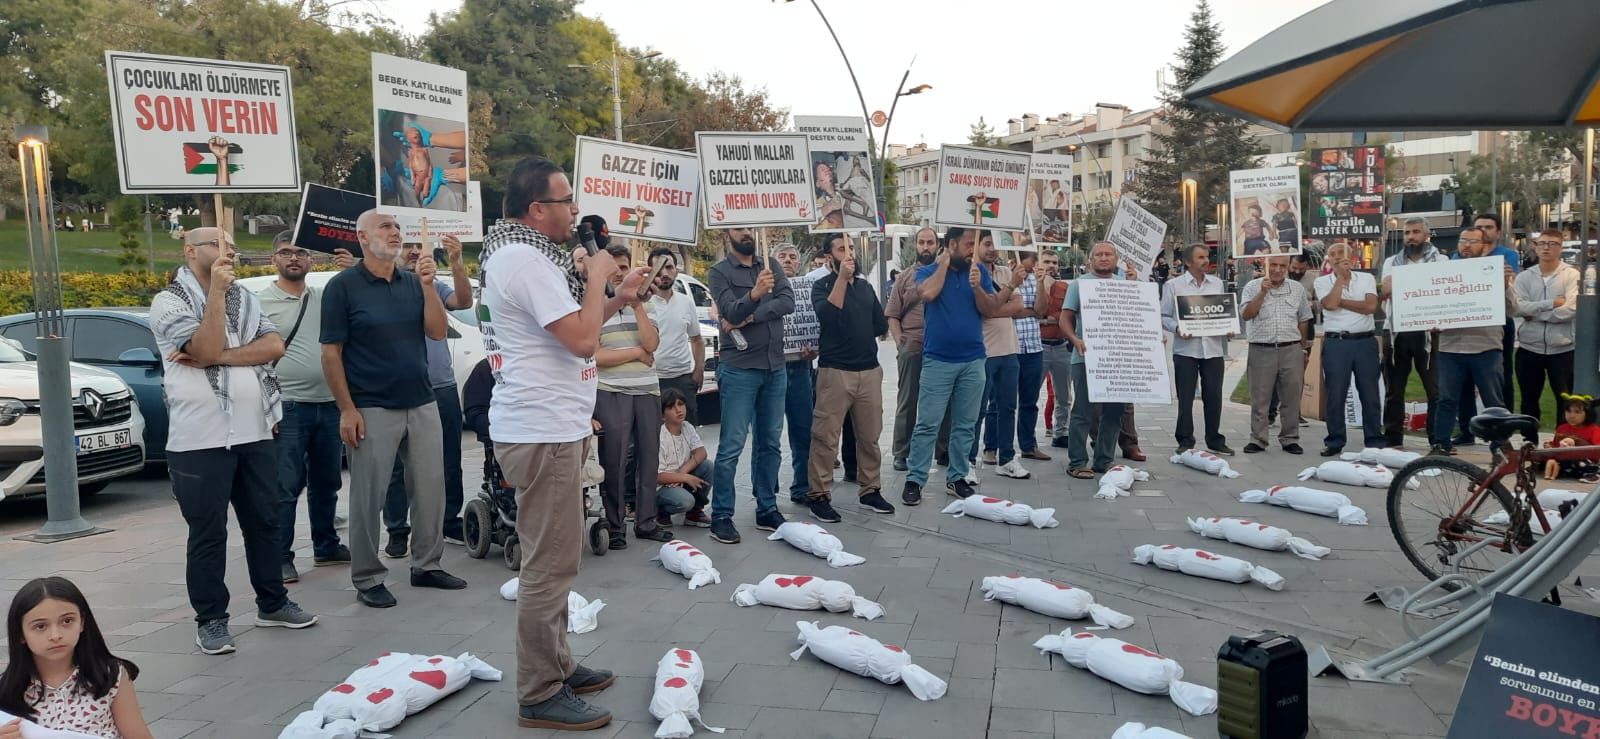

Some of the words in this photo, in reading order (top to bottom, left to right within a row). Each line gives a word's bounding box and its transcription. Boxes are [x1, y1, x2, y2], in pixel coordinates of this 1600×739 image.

[124, 68, 203, 90] ÇOCUKLARI
[207, 71, 281, 96] ÖLDÜRMEYE
[378, 74, 408, 86] BEBEK
[411, 80, 463, 96] KATİLLERİNE
[392, 88, 426, 100] DESTEK
[429, 95, 452, 105] OLMA
[134, 94, 195, 132] SON
[716, 141, 751, 160] YAHUDİ
[754, 144, 794, 160] MALLARI
[602, 154, 646, 176] GAZZE
[650, 157, 679, 181] İÇİN
[963, 156, 990, 171] DÜNYANIN
[709, 165, 749, 186] GAZZELİ
[751, 168, 806, 186] ÇOCUKLARA
[949, 173, 972, 187] SAVAŞ
[974, 176, 992, 188] SUÇU
[584, 176, 631, 200] SESİNİ
[636, 182, 693, 208] YÜKSELT
[725, 189, 759, 210] MERMİ
[761, 192, 797, 209] OLUYOR
[1312, 227, 1348, 235] DESTEK
[1352, 225, 1380, 234] OLMA
[1326, 216, 1365, 226] israile
[1431, 274, 1462, 285] israil
[1404, 288, 1440, 300] yalnız
[1444, 283, 1492, 295] değildir
[81, 437, 93, 449] 42
[98, 434, 109, 447] BL
[114, 432, 128, 444] 867
[1484, 655, 1536, 677] “Benim
[1538, 671, 1600, 695] elimden
[1500, 676, 1574, 704] sorusunun
[1577, 698, 1596, 710] en
